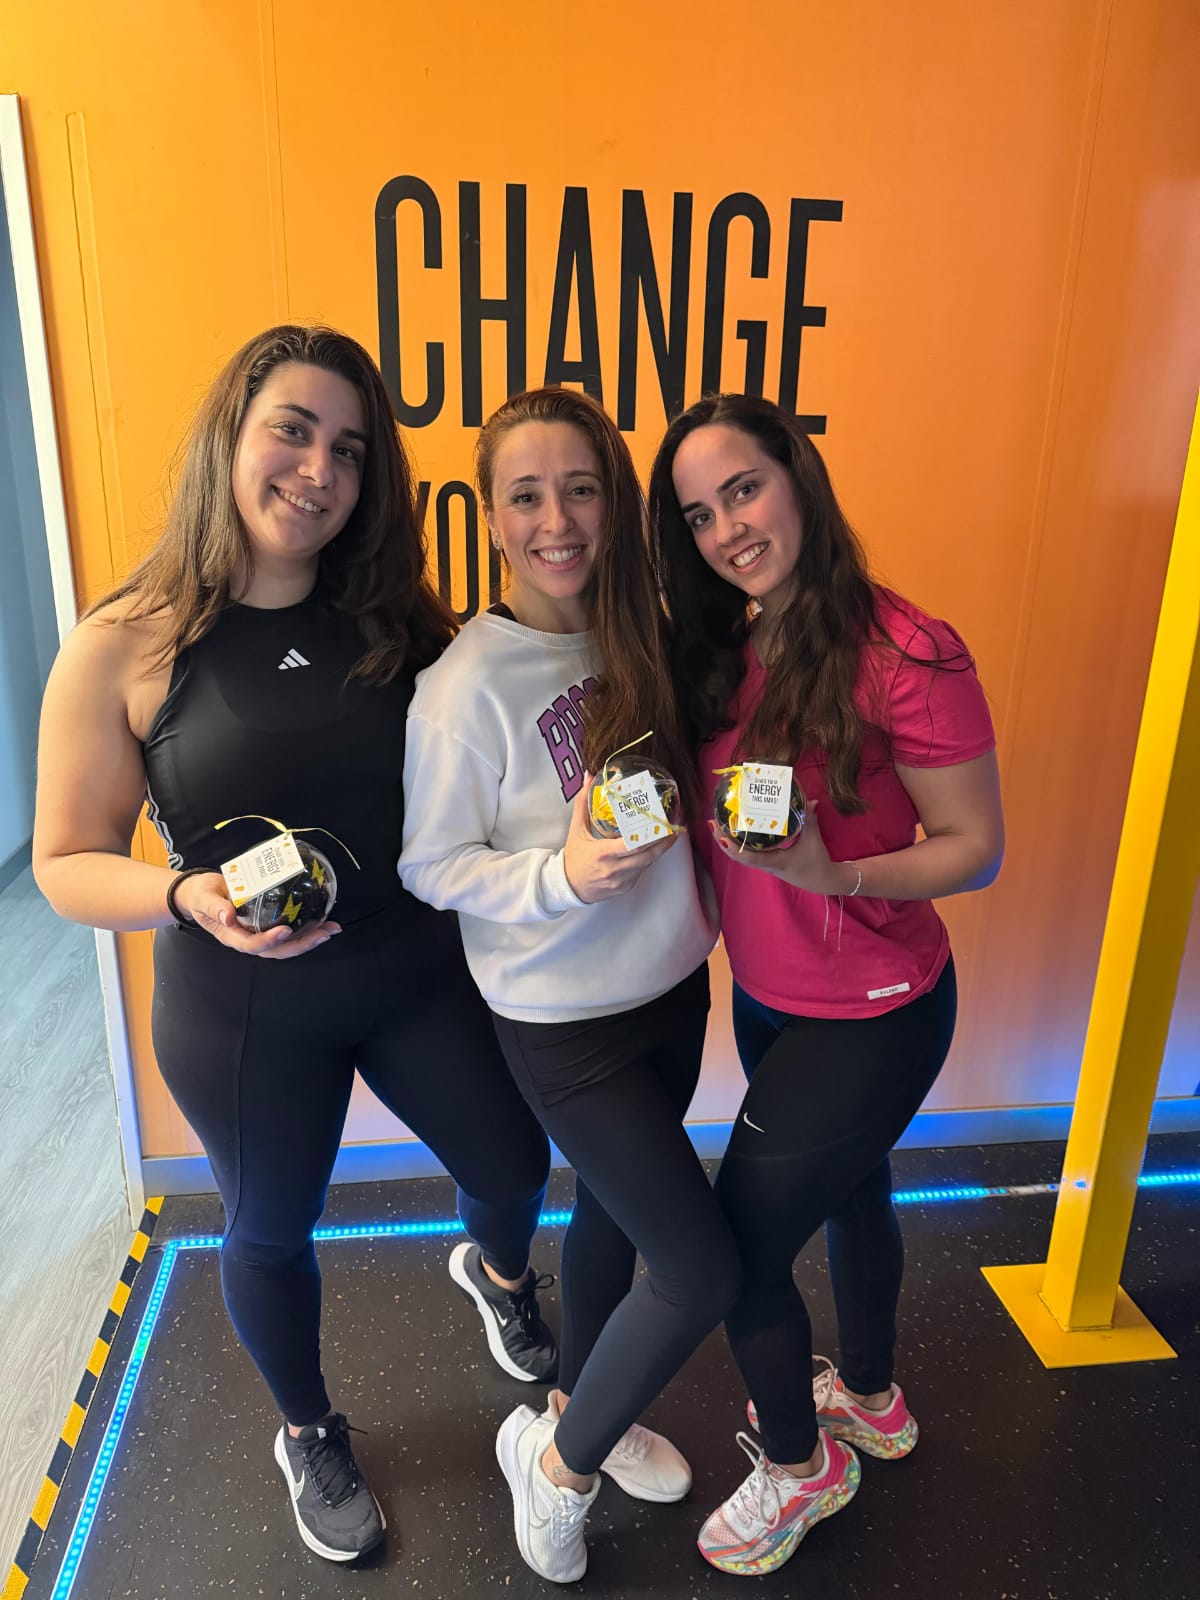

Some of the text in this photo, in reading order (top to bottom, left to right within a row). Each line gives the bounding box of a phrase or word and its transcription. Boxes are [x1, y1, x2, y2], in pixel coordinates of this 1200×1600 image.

[374, 175, 844, 435] CHANGE
[749, 783, 782, 796] ENERGY
[261, 847, 280, 876] ENERGY
